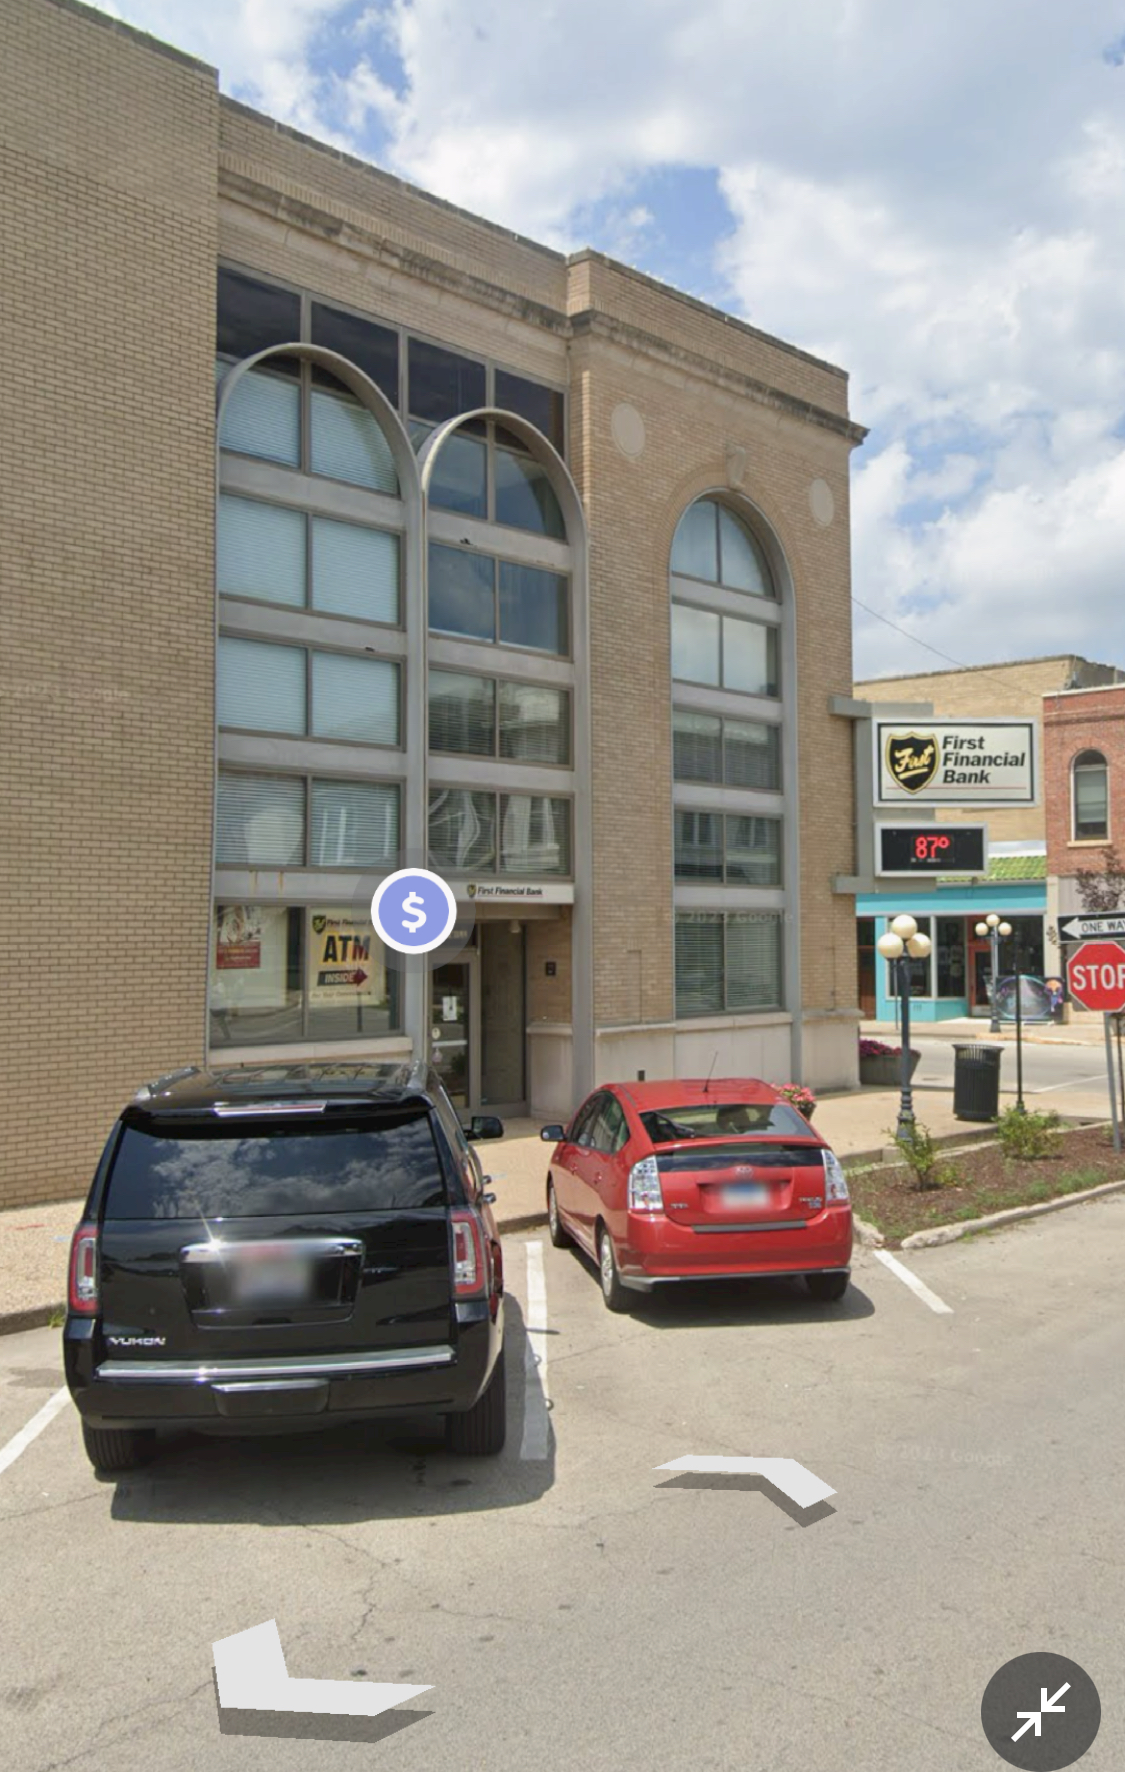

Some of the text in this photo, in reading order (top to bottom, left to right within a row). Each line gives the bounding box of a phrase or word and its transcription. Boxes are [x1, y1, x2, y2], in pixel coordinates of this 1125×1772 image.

[942, 735, 985, 750] First
[942, 752, 1026, 767] Financial
[942, 769, 991, 784] Bank
[477, 886, 543, 895] First Financial Bank
[1081, 921, 1104, 933] ONE
[322, 934, 371, 963] ATM
[324, 972, 356, 984] INSIDE
[108, 1336, 166, 1346] YUKON
